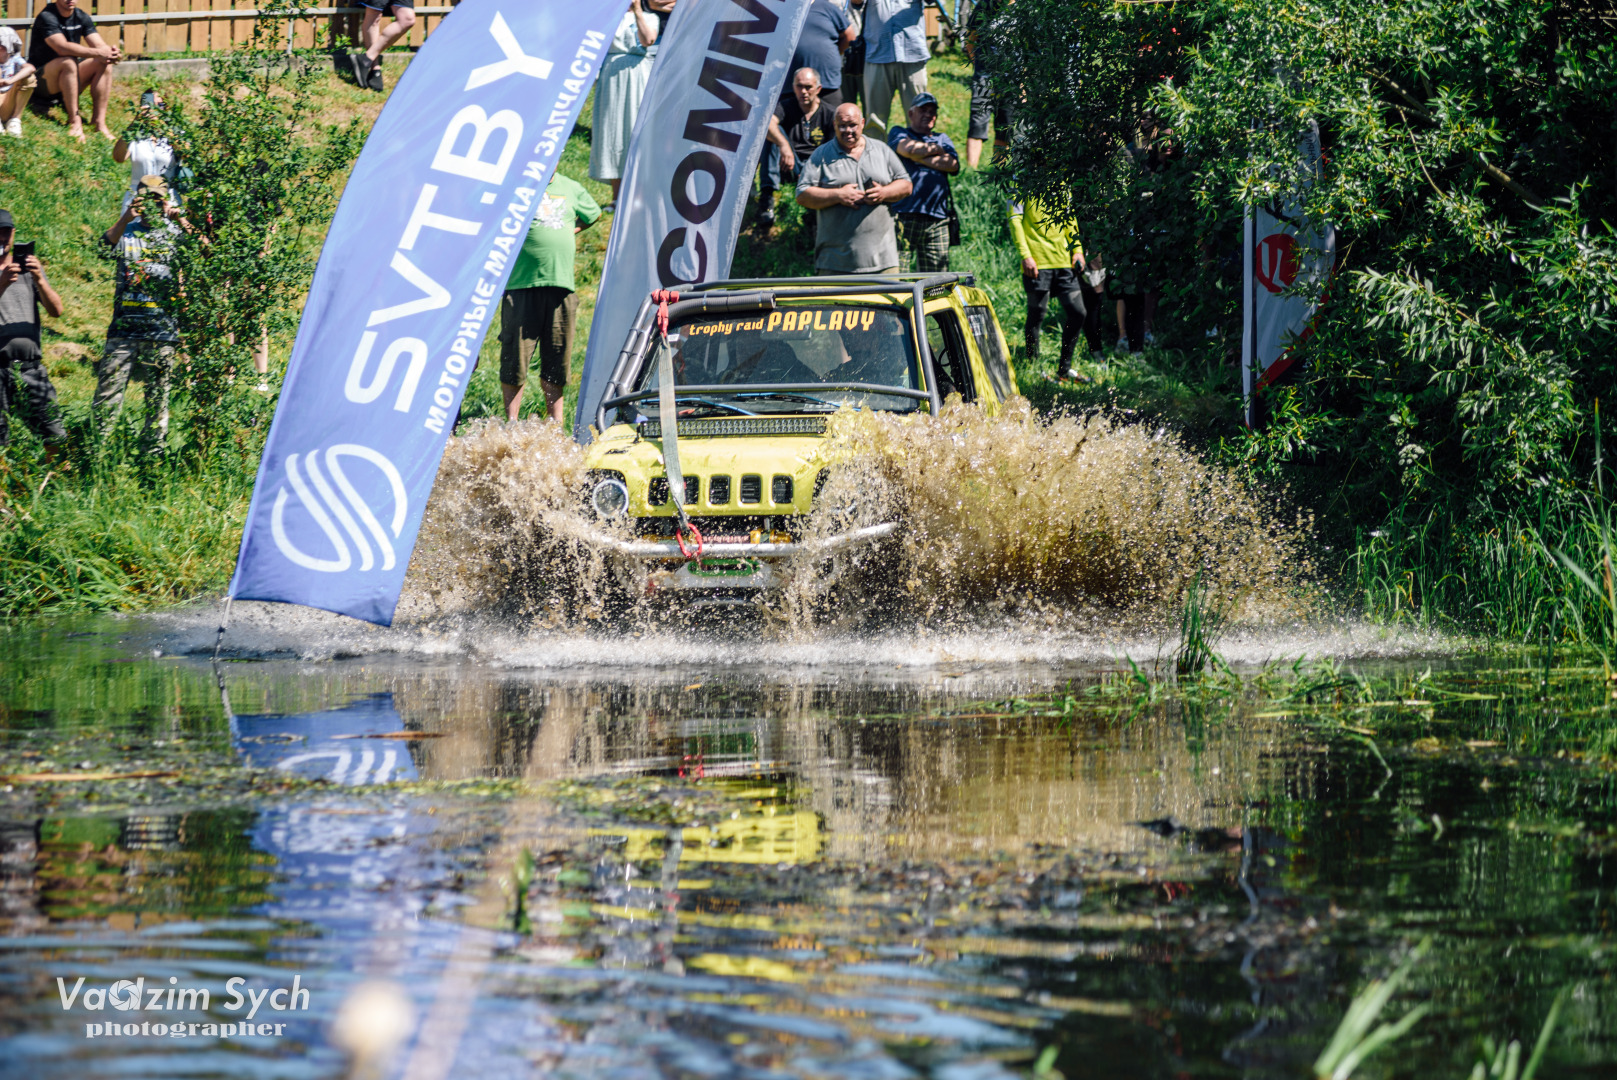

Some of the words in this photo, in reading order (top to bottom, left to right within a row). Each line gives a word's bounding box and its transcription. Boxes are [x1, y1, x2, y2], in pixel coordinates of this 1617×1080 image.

[533, 29, 607, 157] ЗАПЧАСТИ
[344, 11, 554, 413] SVT.BY
[522, 160, 547, 182] И
[483, 186, 536, 277] МАСЛА
[423, 277, 497, 435] МОТОРНЫЕ
[689, 321, 733, 336] trophy
[735, 318, 765, 331] raid
[766, 310, 875, 332] PAPLAVY
